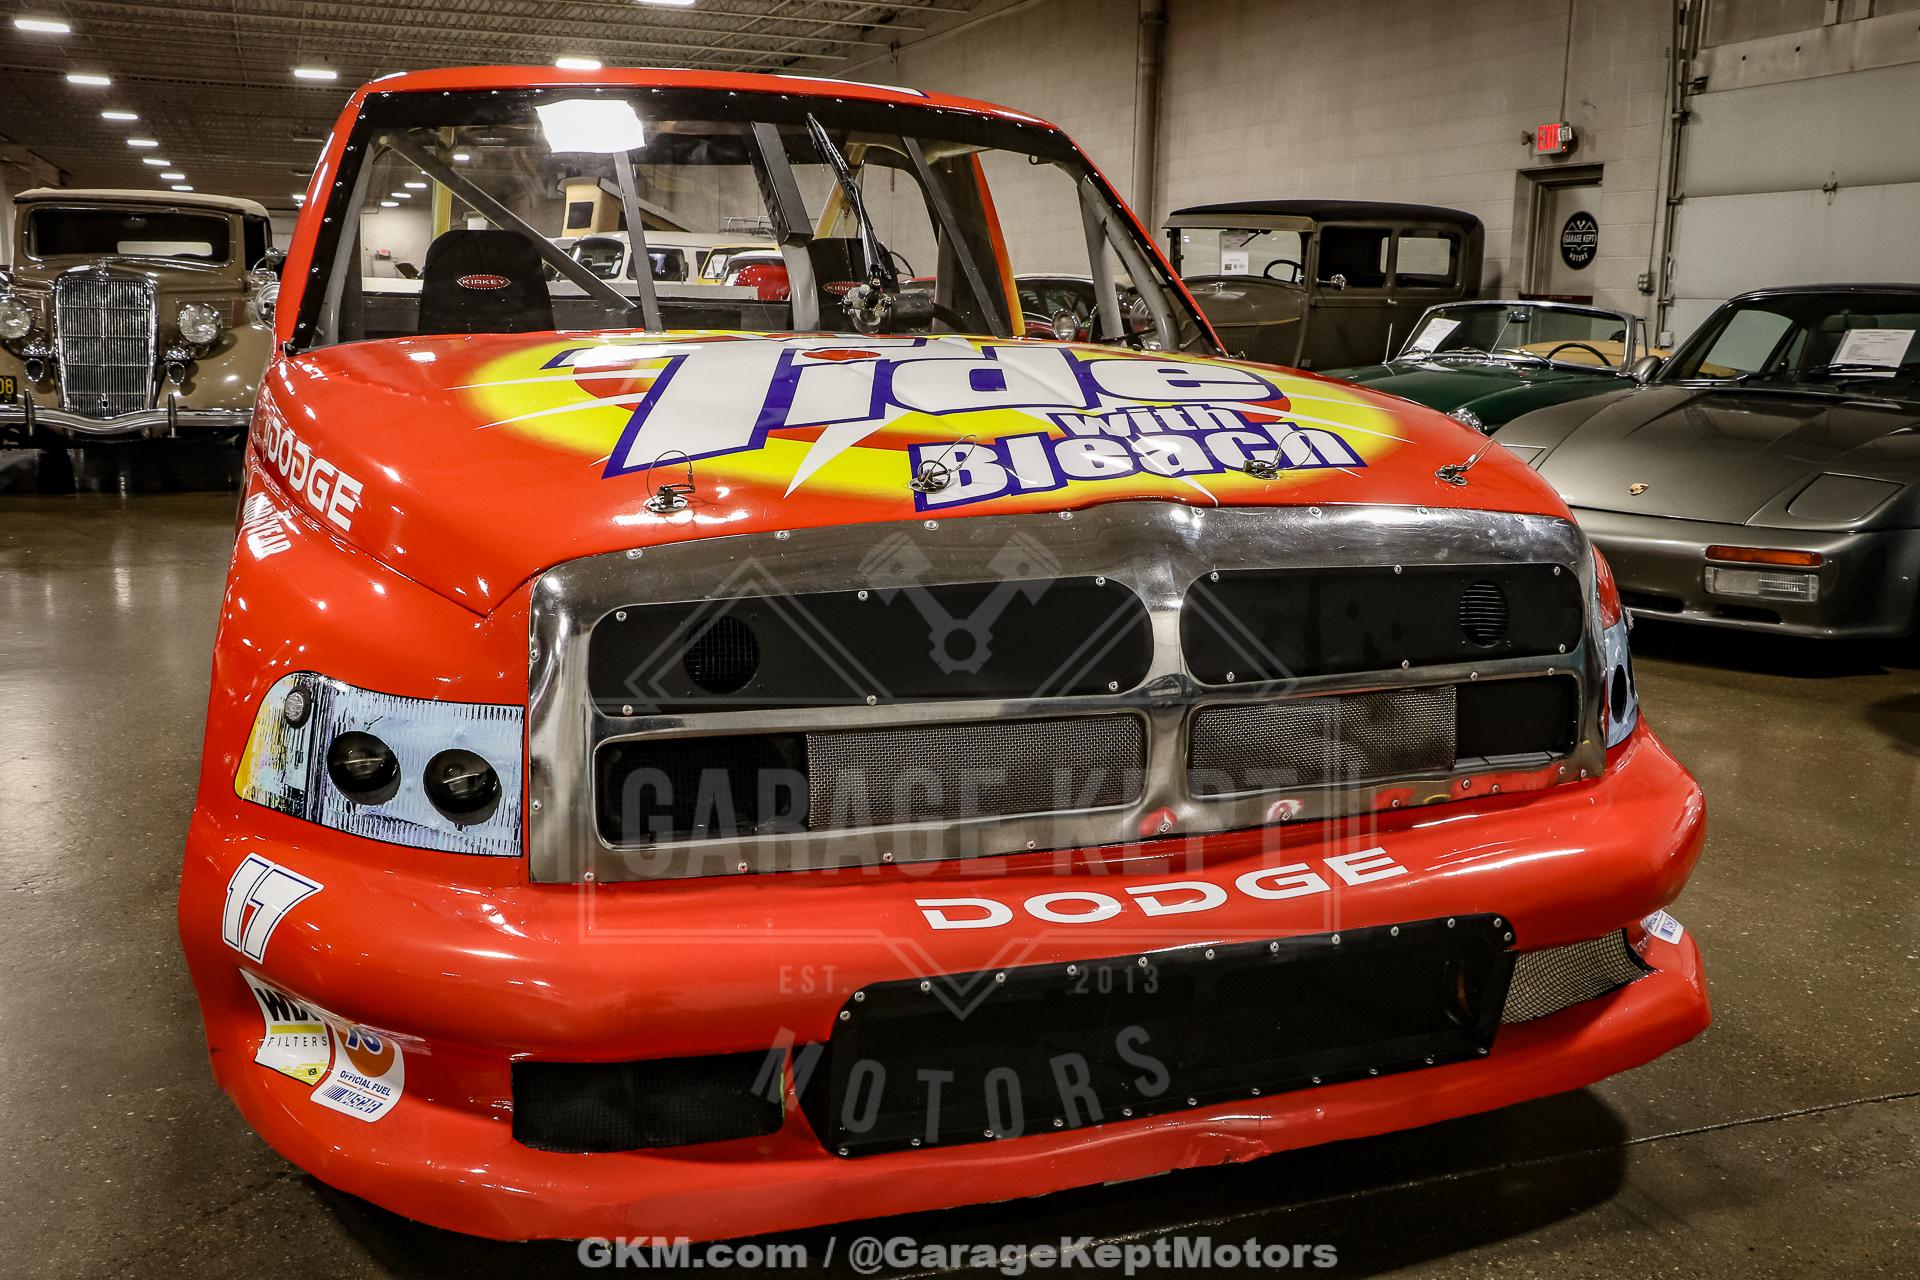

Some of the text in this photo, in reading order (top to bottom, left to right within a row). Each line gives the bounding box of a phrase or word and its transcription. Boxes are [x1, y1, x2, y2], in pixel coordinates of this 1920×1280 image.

[1537, 124, 1562, 151] EXIT
[540, 336, 1289, 479] Tide
[1055, 403, 1247, 438] with
[266, 417, 364, 532] DODGE
[910, 420, 1368, 512] Bleach
[223, 852, 324, 964] 17
[915, 847, 1408, 930] DODGE
[267, 1036, 328, 1047] FILTERS
[340, 1070, 371, 1089] OFFICIAL
[372, 1083, 391, 1097] FUEL
